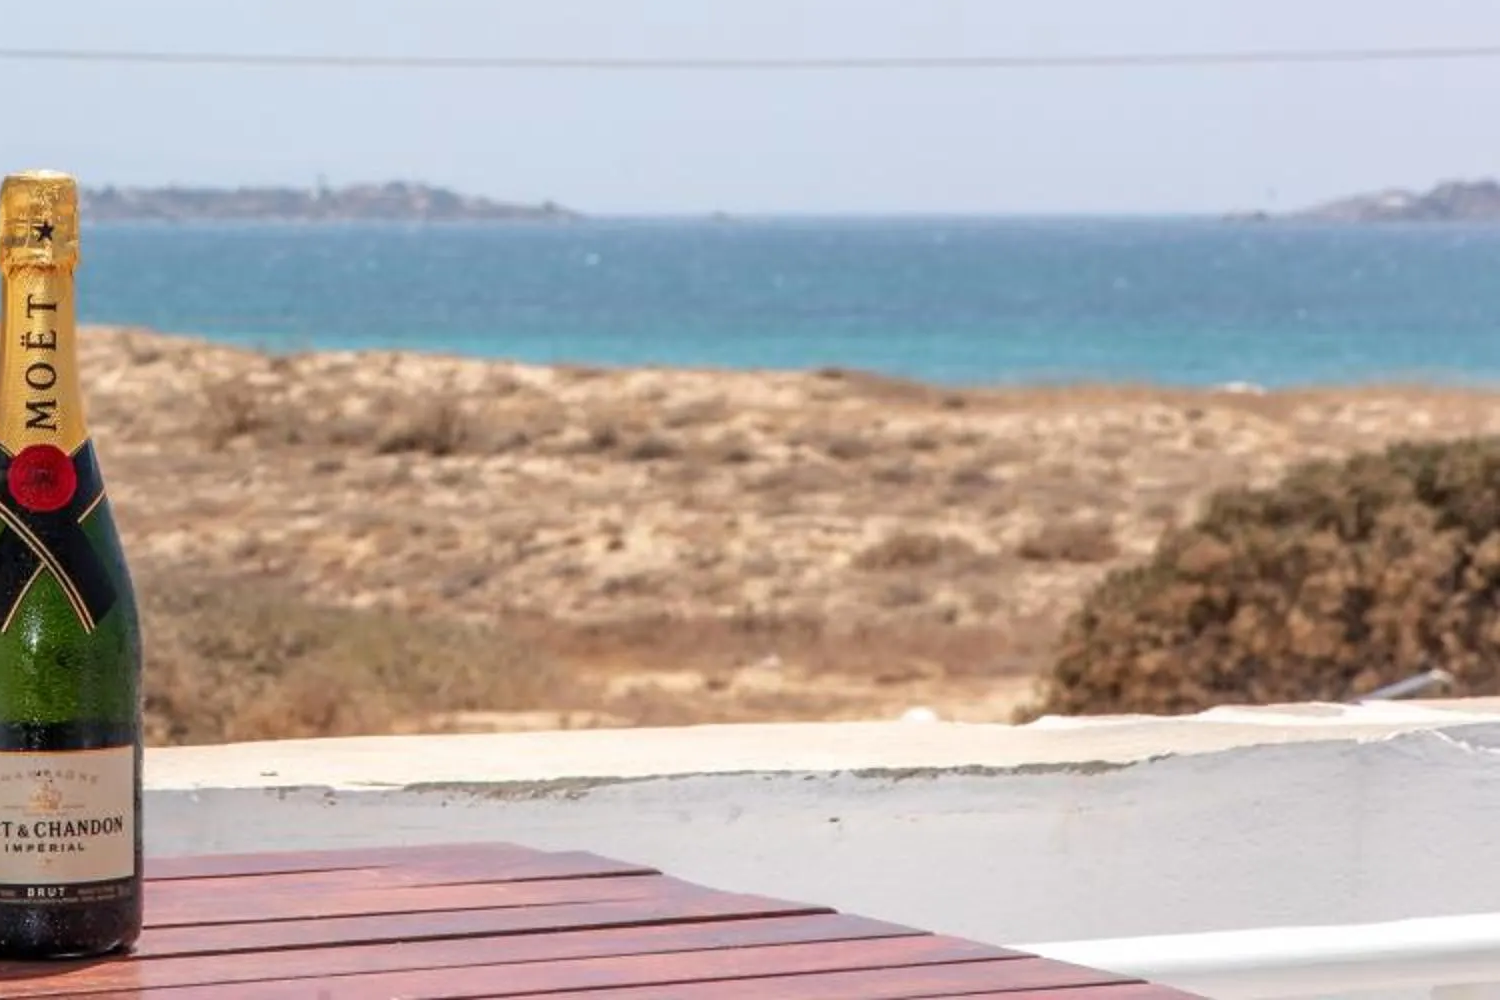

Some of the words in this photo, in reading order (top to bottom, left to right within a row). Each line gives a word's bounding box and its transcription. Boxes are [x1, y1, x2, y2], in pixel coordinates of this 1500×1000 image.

[20, 294, 58, 432] MOËT
[17, 824, 29, 838] &
[33, 815, 124, 838] CHANDON
[26, 887, 66, 898] BRUT
